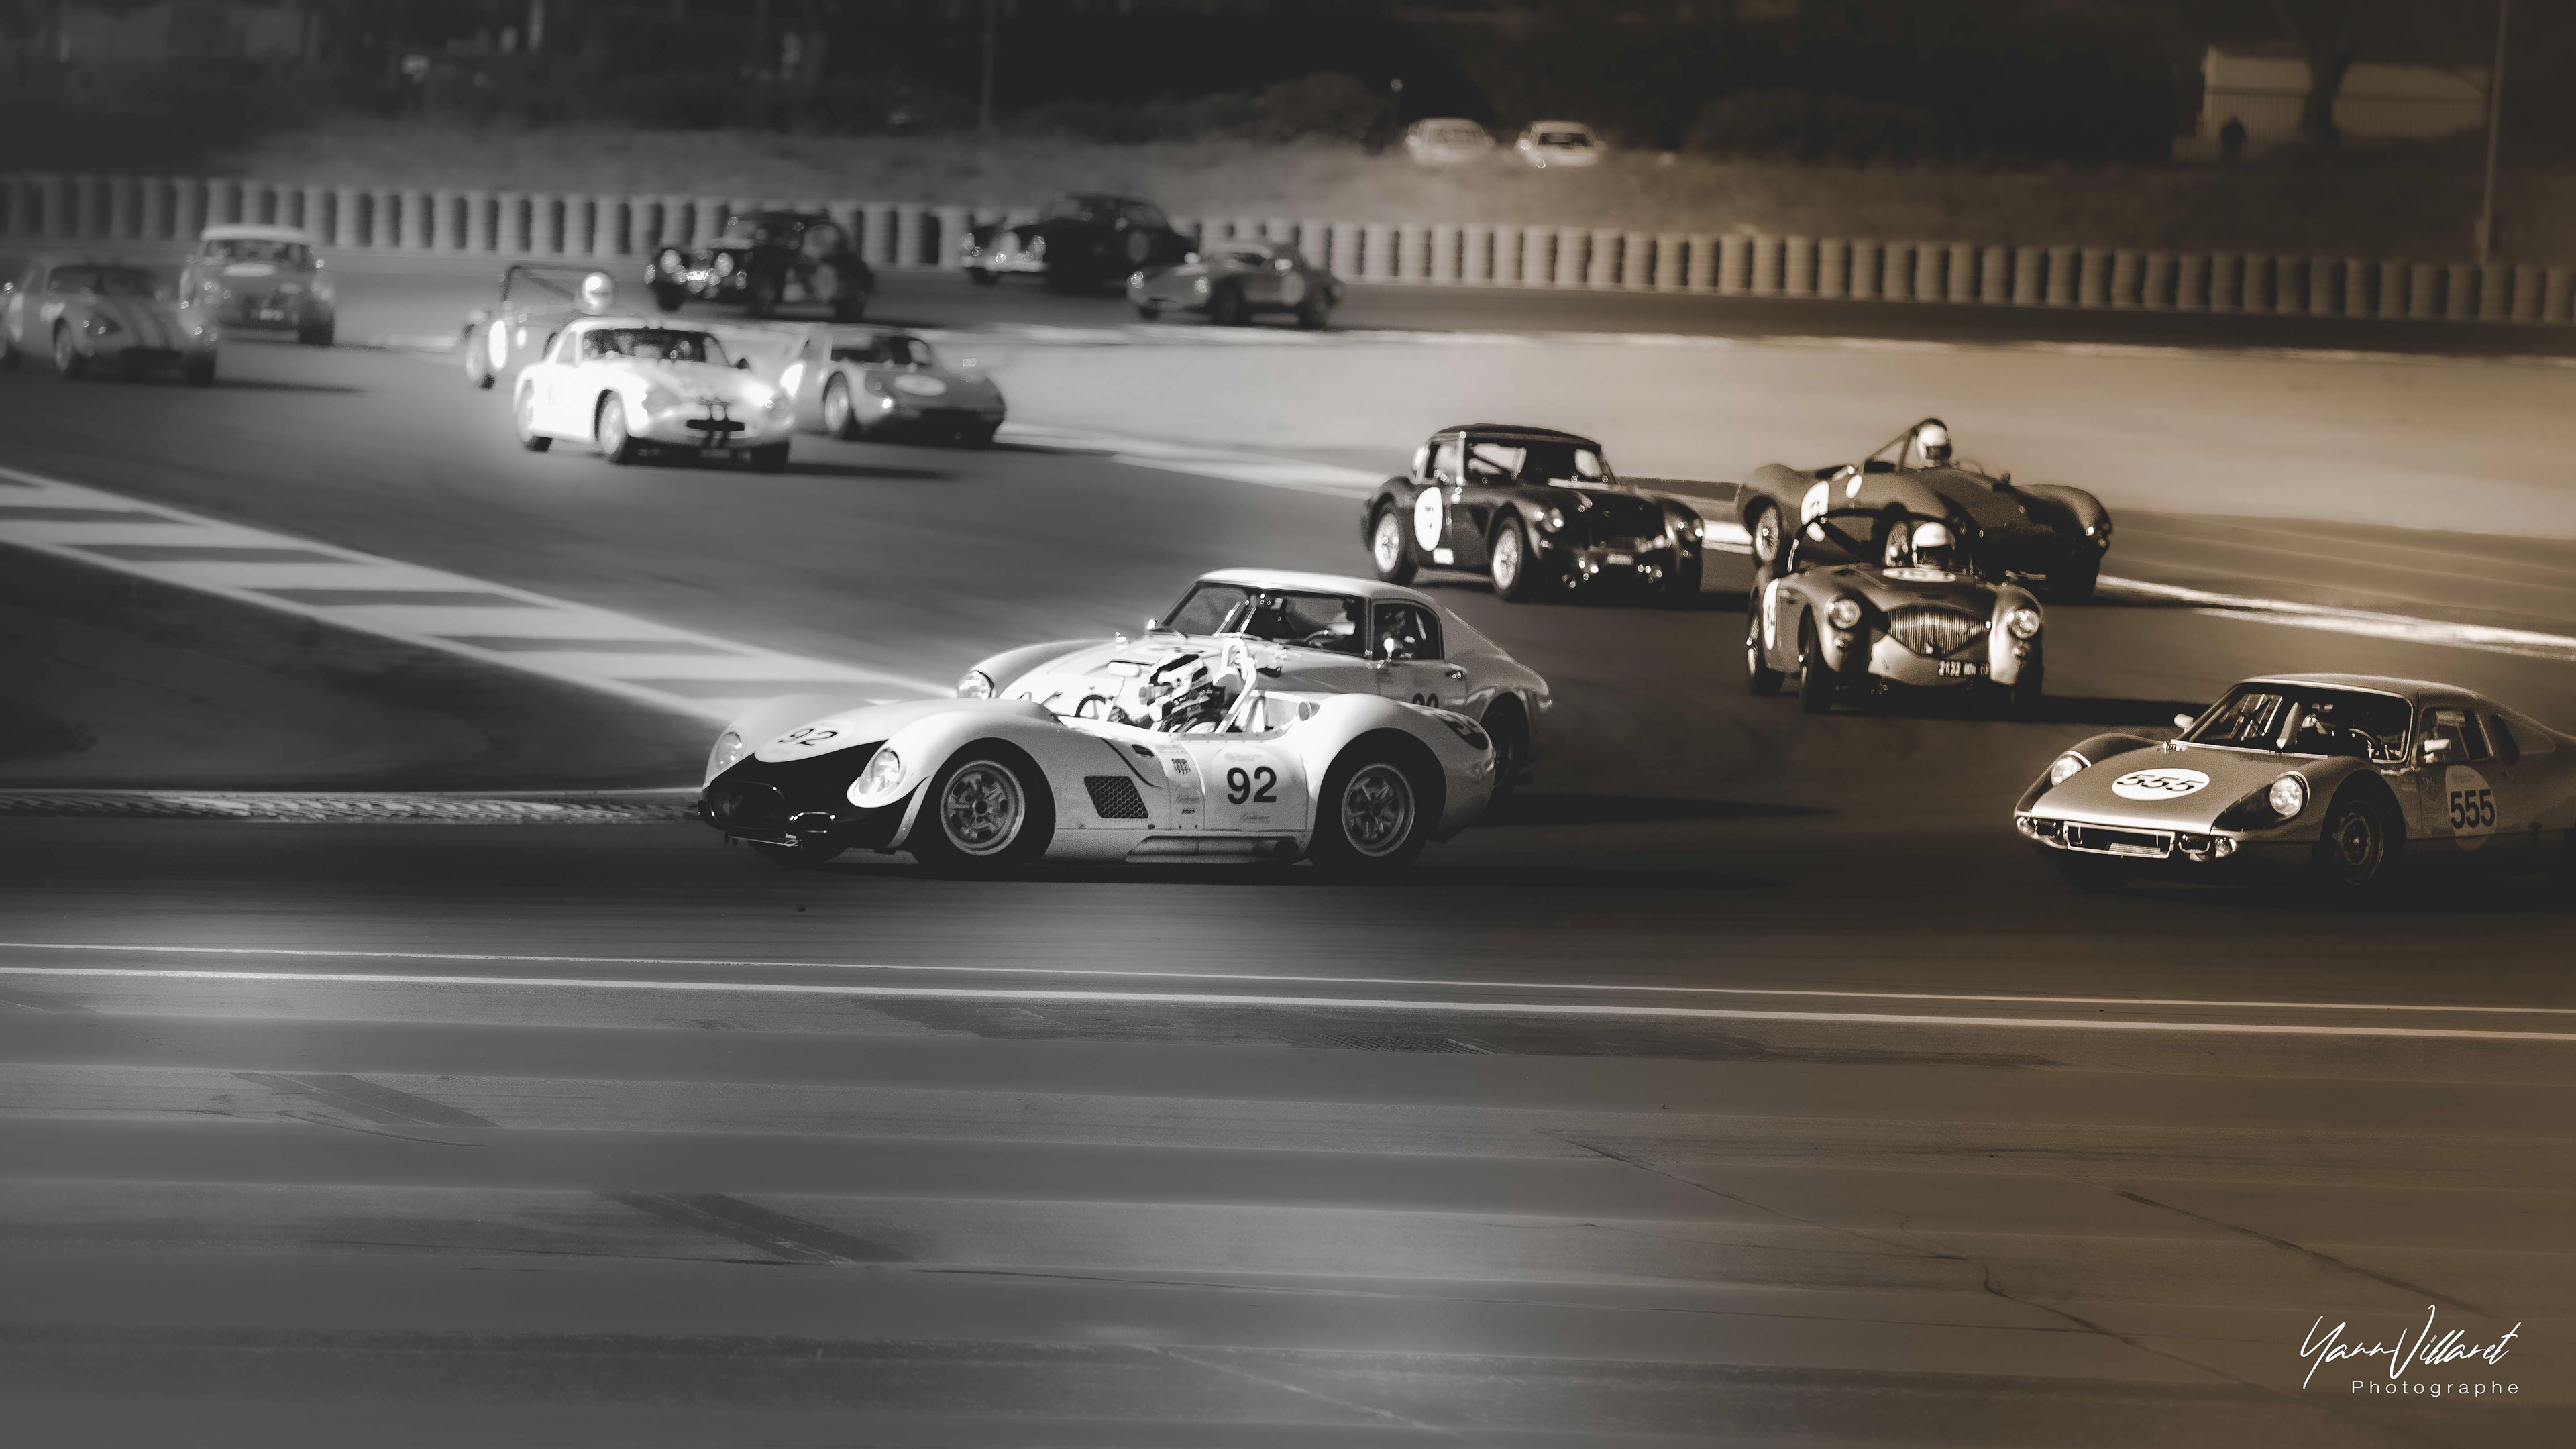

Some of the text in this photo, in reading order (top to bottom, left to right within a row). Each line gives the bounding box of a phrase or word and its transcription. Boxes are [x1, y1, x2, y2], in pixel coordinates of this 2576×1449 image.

[777, 727, 838, 747] 92
[1226, 765, 1277, 804] 92
[2116, 773, 2205, 792] 555
[2450, 788, 2496, 829] 555
